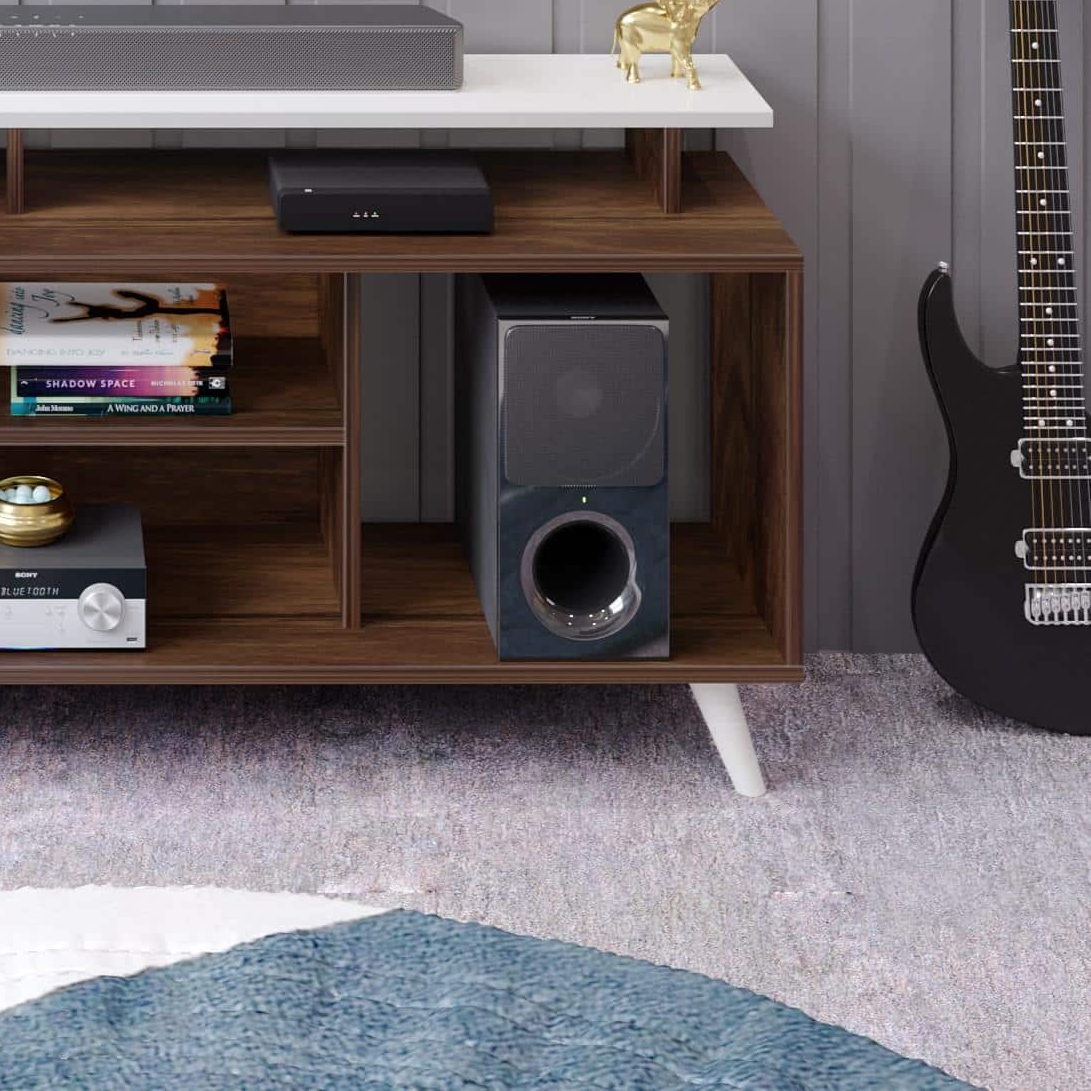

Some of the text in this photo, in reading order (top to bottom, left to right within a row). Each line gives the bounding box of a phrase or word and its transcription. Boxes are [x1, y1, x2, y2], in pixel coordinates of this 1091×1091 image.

[31, 288, 76, 307] Joy
[45, 379, 136, 388] SHADOW SPACE
[107, 403, 195, 413] A WING AND A PRAYER
[0, 586, 60, 596] BLUETOOTH
